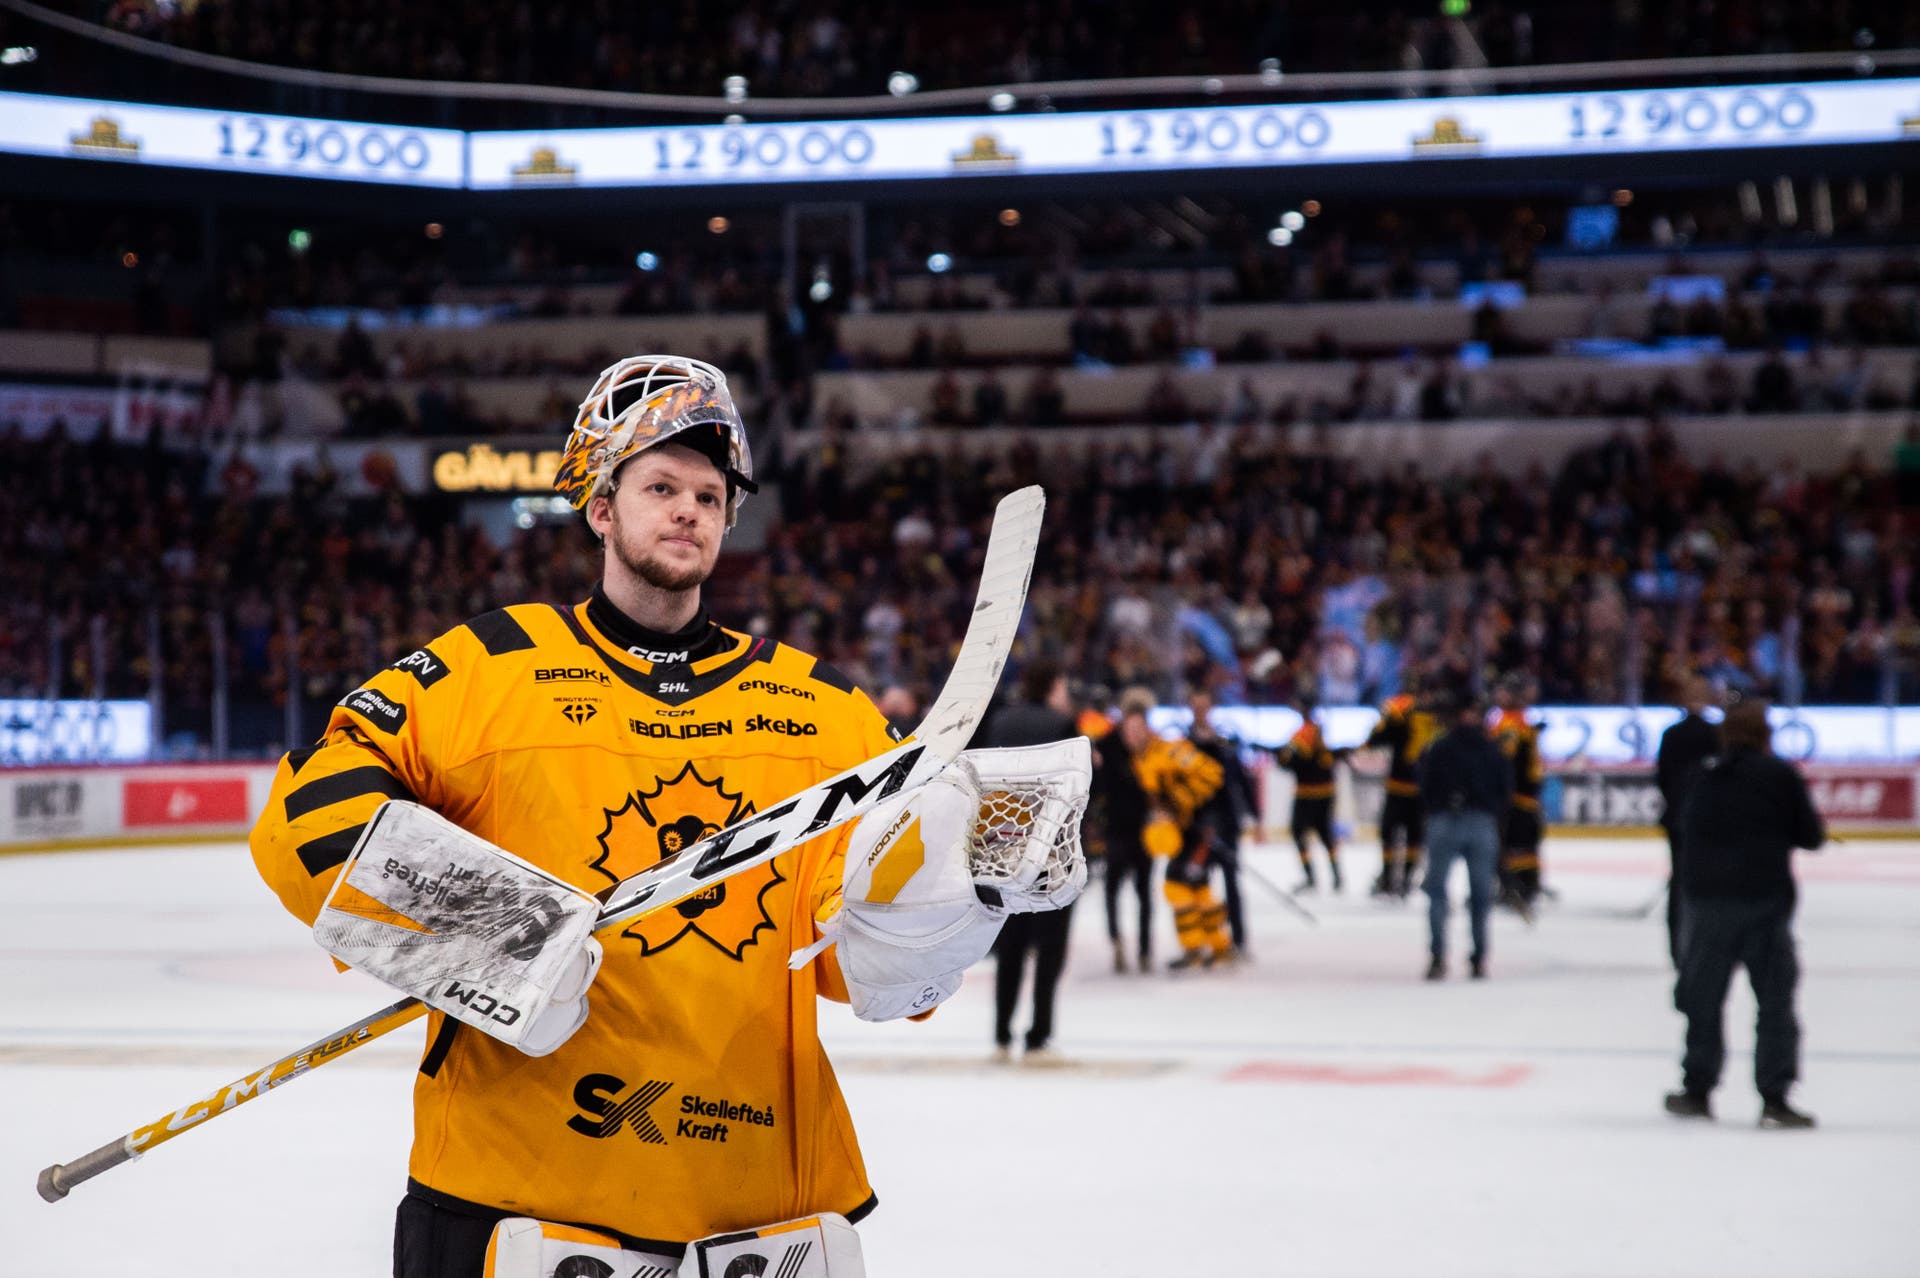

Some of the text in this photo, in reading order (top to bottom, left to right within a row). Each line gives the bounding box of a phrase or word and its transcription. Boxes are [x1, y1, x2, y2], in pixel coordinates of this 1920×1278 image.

[626, 645, 690, 664] CCM
[658, 682, 690, 693] SHL
[738, 679, 816, 702] engcon
[655, 708, 696, 717] CCM
[634, 719, 733, 740] BOLIDEN
[745, 714, 818, 737] skebo
[868, 809, 911, 867] SHADOW
[443, 981, 521, 1026] CCM
[680, 1095, 775, 1127] Skellefteå
[676, 1118, 729, 1143] Kraft
